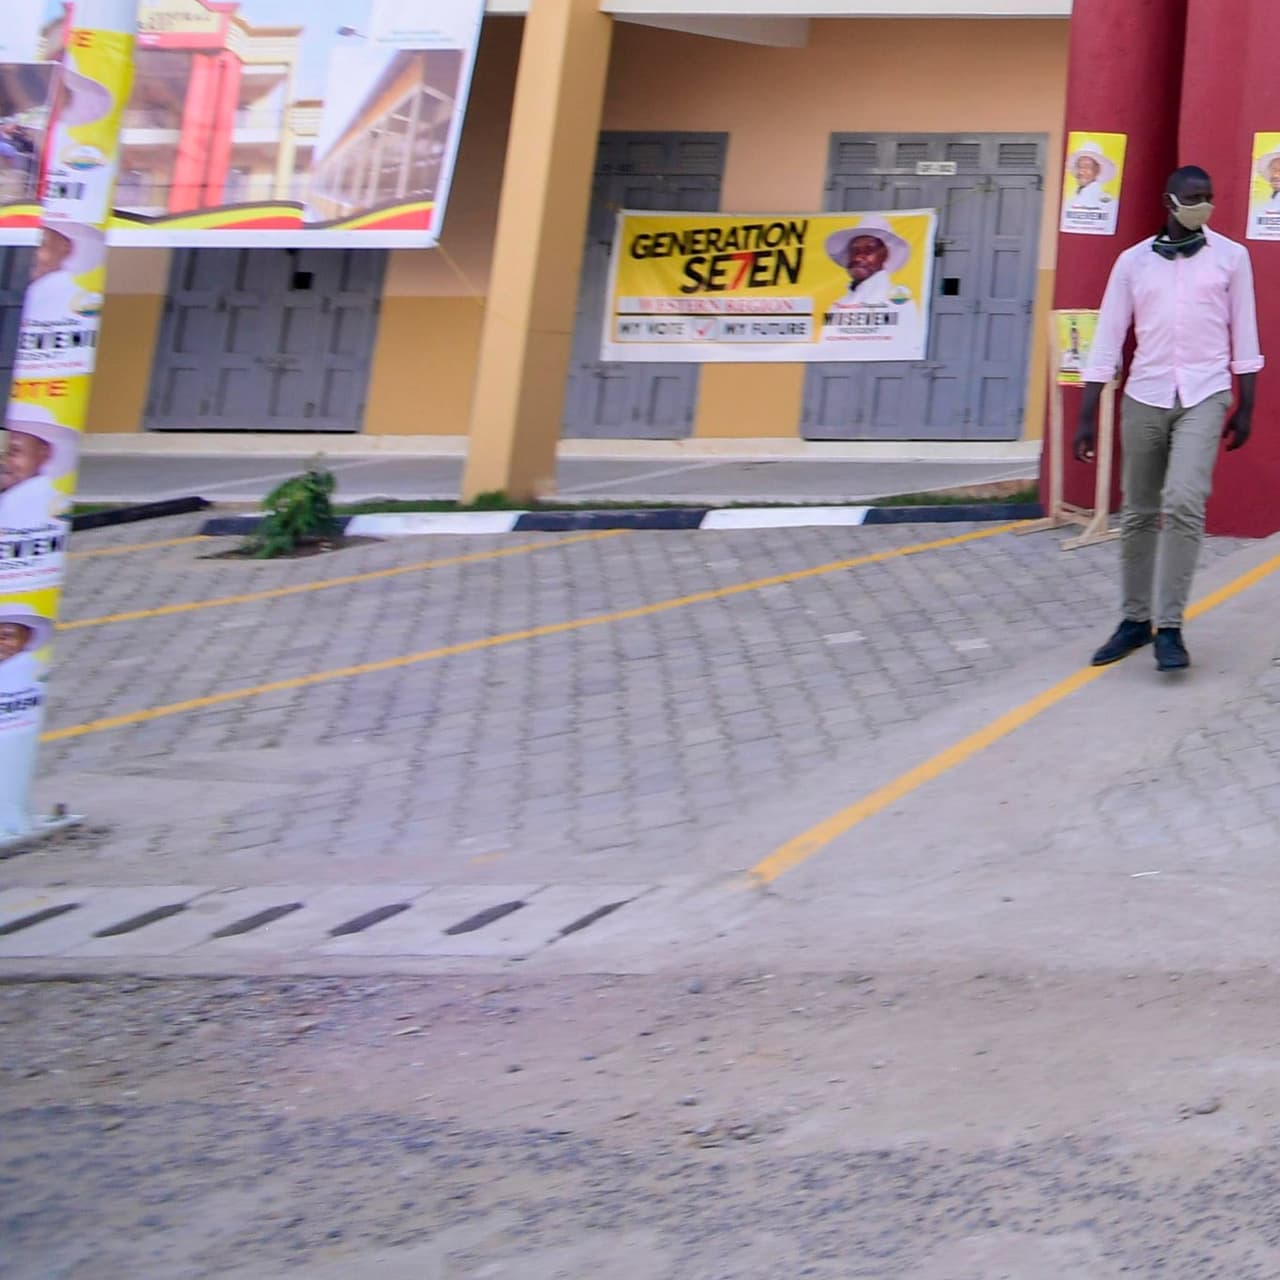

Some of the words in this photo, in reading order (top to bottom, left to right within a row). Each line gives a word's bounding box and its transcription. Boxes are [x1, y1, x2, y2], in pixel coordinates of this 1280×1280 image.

[630, 219, 808, 260] GENERATION
[680, 246, 804, 294] SE7EN
[752, 322, 809, 335] FUTURE
